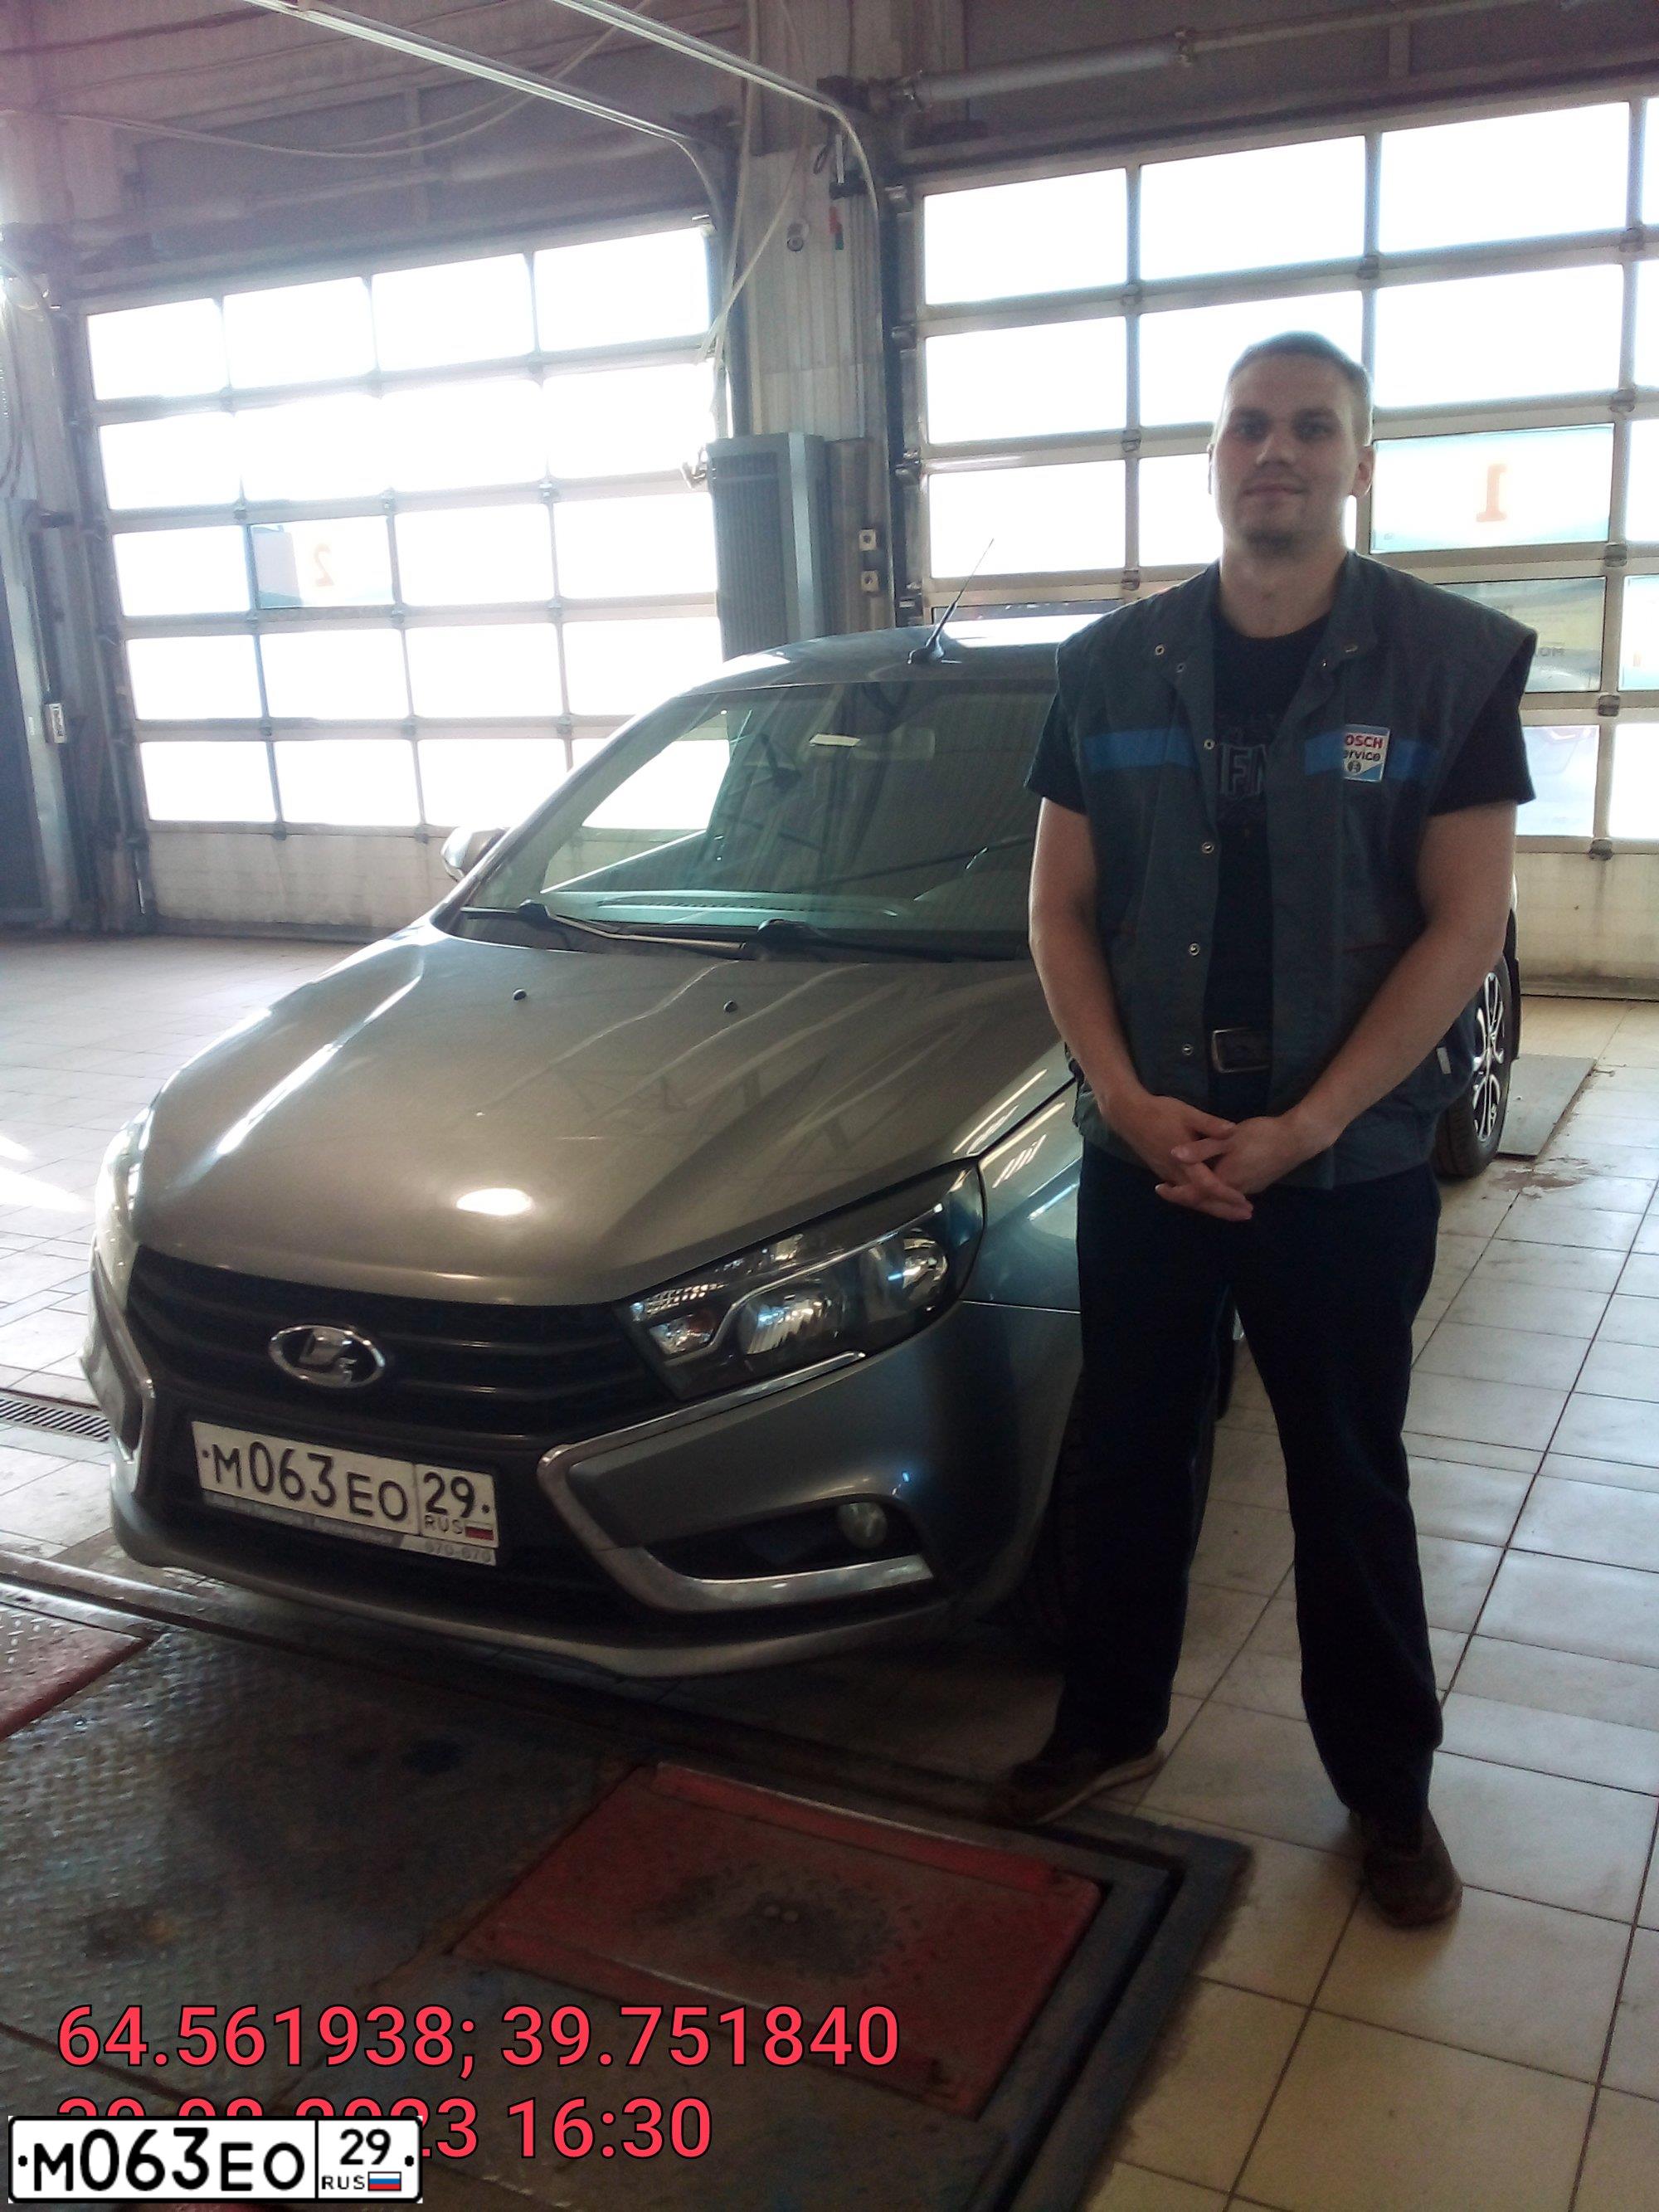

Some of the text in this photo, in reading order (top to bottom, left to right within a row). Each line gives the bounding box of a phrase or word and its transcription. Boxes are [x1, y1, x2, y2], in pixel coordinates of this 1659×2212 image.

[1344, 734, 1384, 748] OSCH
[1342, 749, 1381, 762] ervice
[424, 1471, 475, 1518] 29
[425, 1514, 464, 1535] RUS
